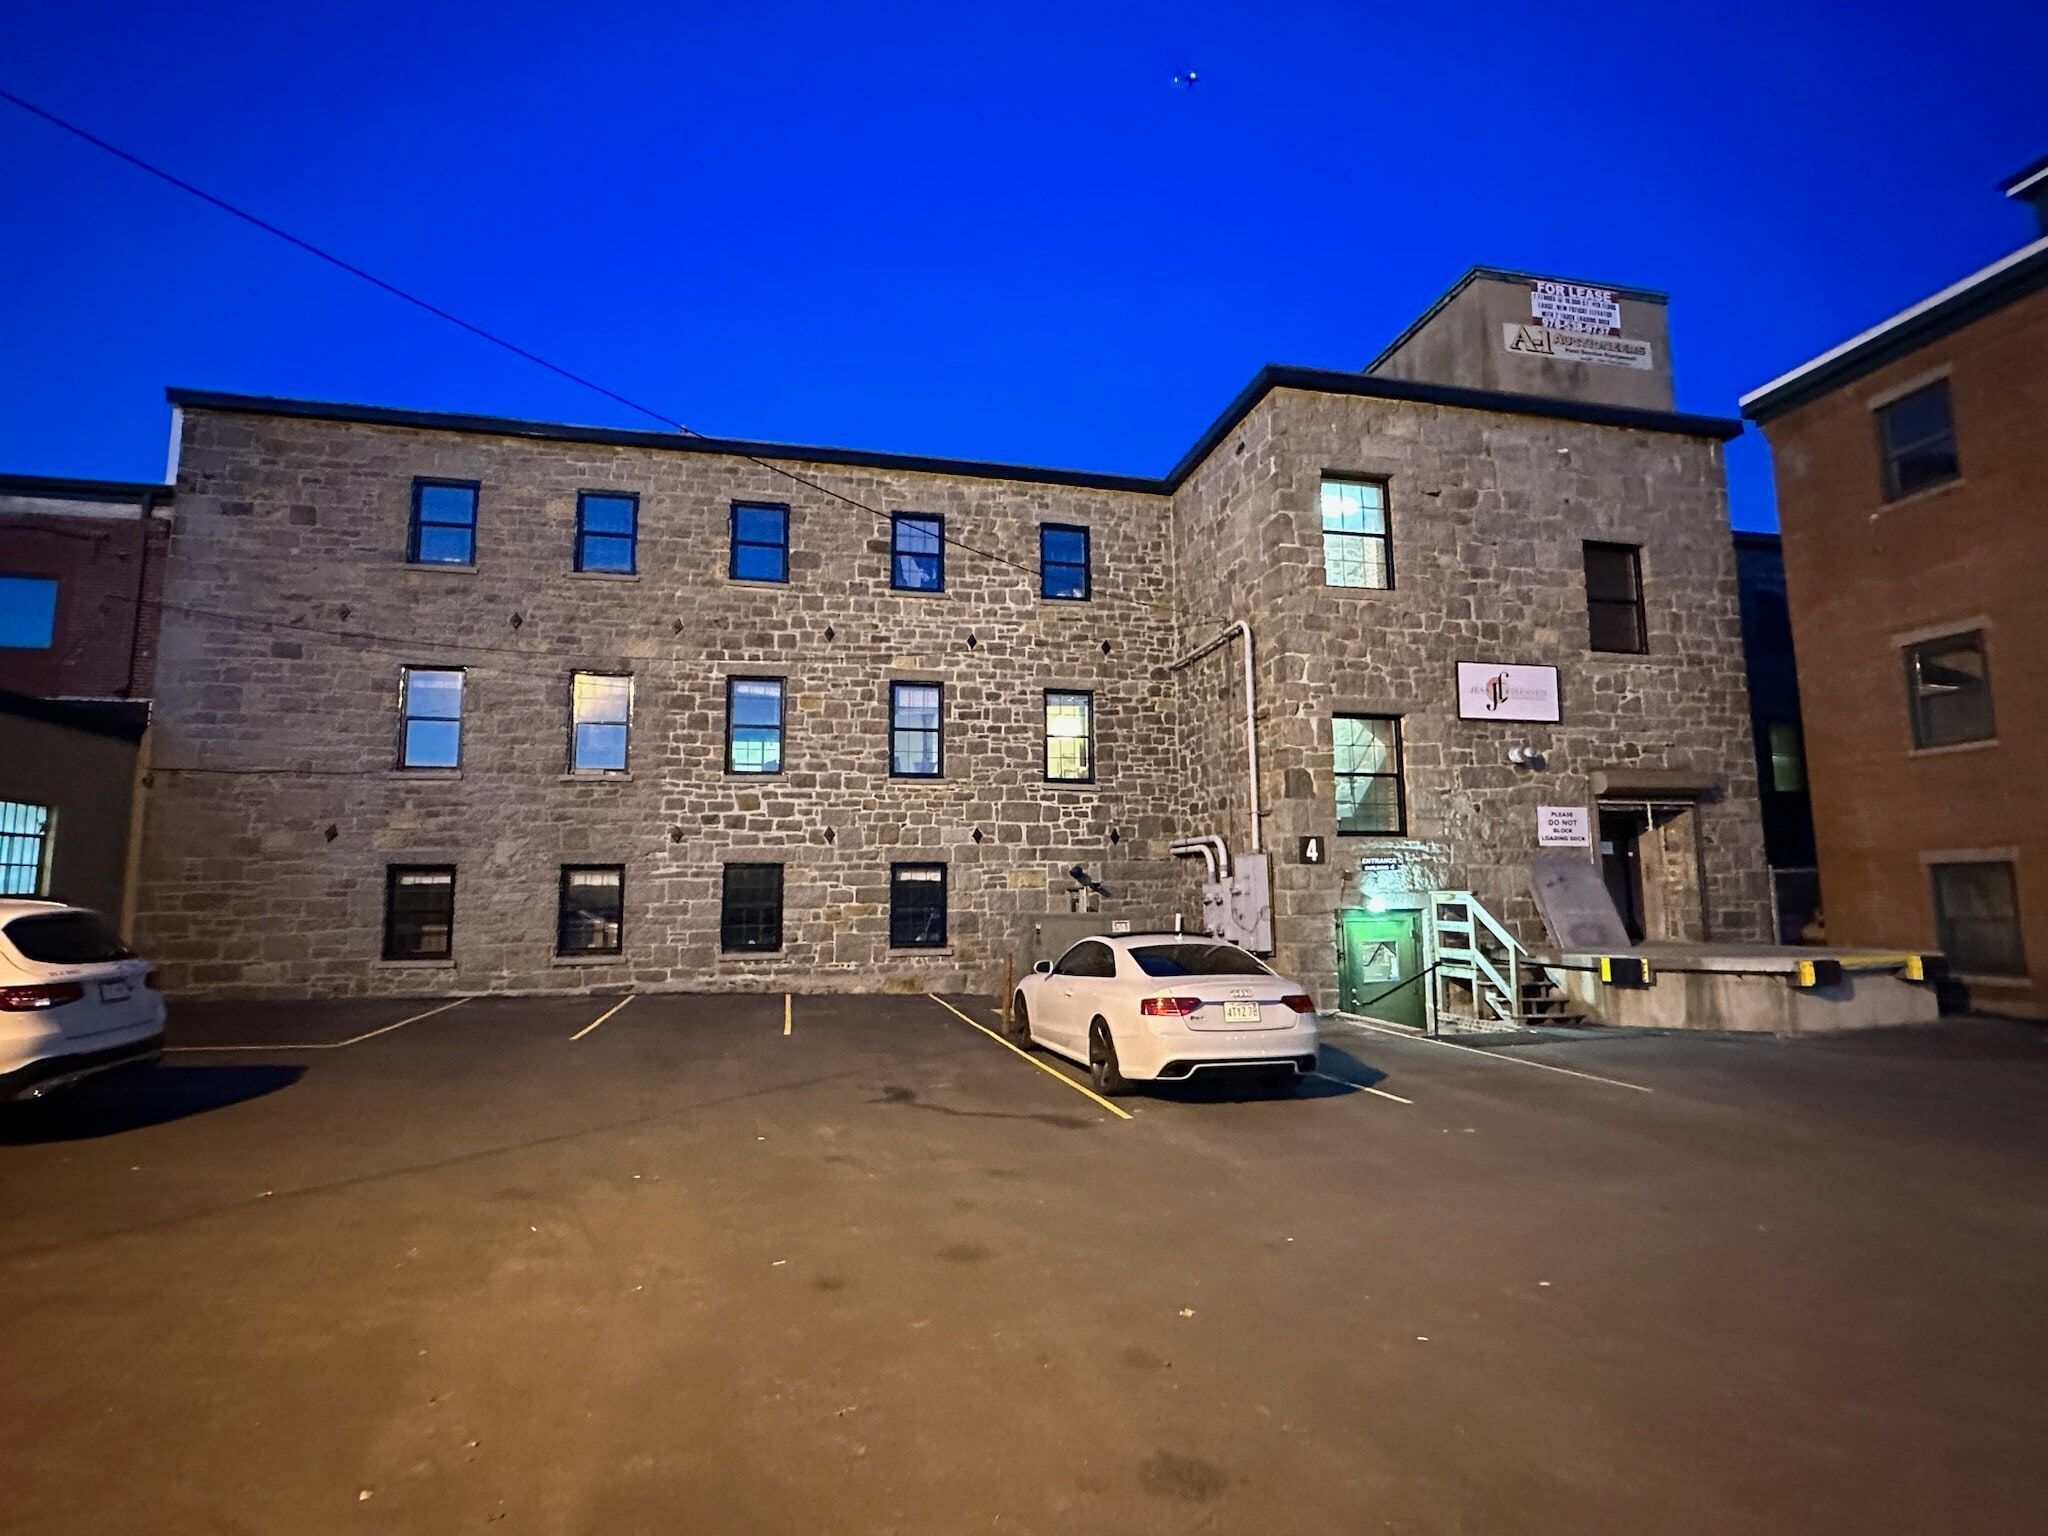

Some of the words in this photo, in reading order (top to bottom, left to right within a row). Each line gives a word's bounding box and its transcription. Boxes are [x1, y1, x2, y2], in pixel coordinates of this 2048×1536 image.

[1537, 282, 1565, 296] FOR
[1568, 286, 1612, 303] LEASE
[1305, 838, 1319, 862] 4
